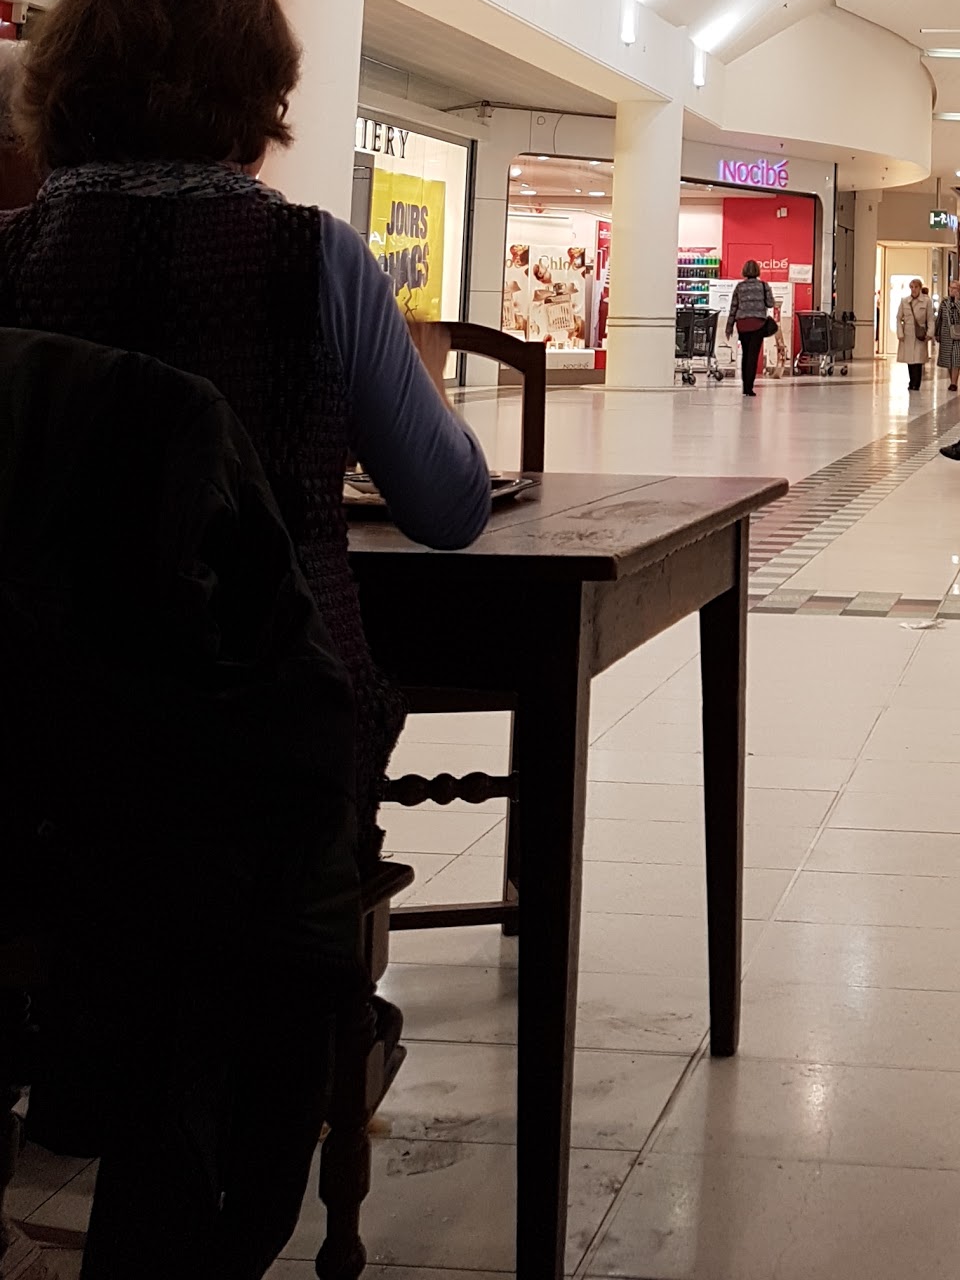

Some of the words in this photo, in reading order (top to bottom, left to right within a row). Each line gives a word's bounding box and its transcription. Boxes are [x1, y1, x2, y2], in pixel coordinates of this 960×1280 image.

[354, 119, 410, 159] IERY
[719, 159, 789, 188] Nocibé
[386, 200, 428, 240] JOURS
[755, 258, 788, 269] ocibé
